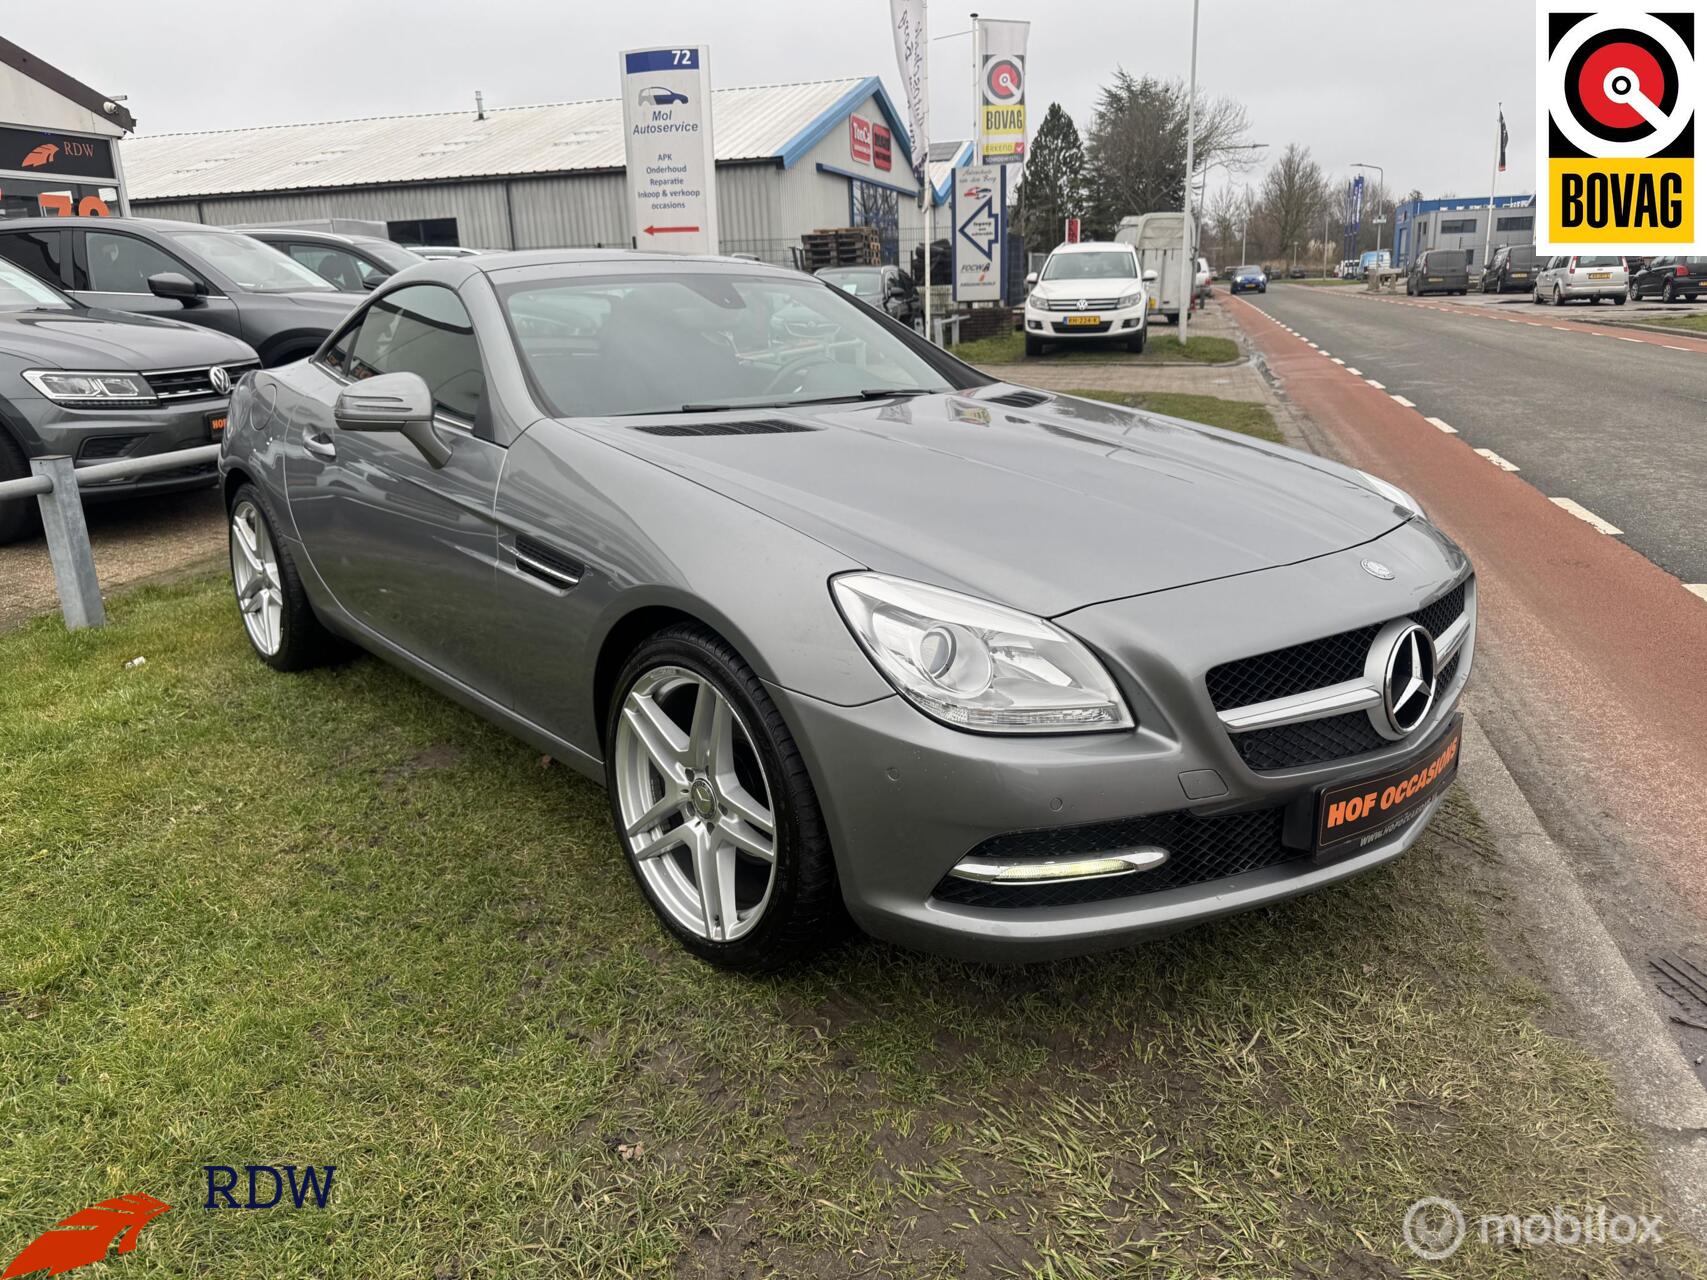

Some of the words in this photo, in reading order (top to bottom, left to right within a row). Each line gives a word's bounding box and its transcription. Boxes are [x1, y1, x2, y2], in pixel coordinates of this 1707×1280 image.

[672, 49, 692, 66] 72
[652, 109, 672, 122] Mol
[986, 110, 1023, 130] BOVAG
[633, 121, 699, 136] Autoservice
[63, 141, 95, 158] RDW
[657, 153, 673, 161] APK
[646, 164, 687, 174] Onderhoud
[650, 177, 685, 187] Reparatie
[638, 190, 660, 199] Inkoop
[661, 189, 668, 197] &
[669, 188, 700, 198] verkoop
[651, 201, 686, 210] occasions
[1327, 792, 1377, 828] HOF
[1380, 736, 1458, 810] OCCASIONS
